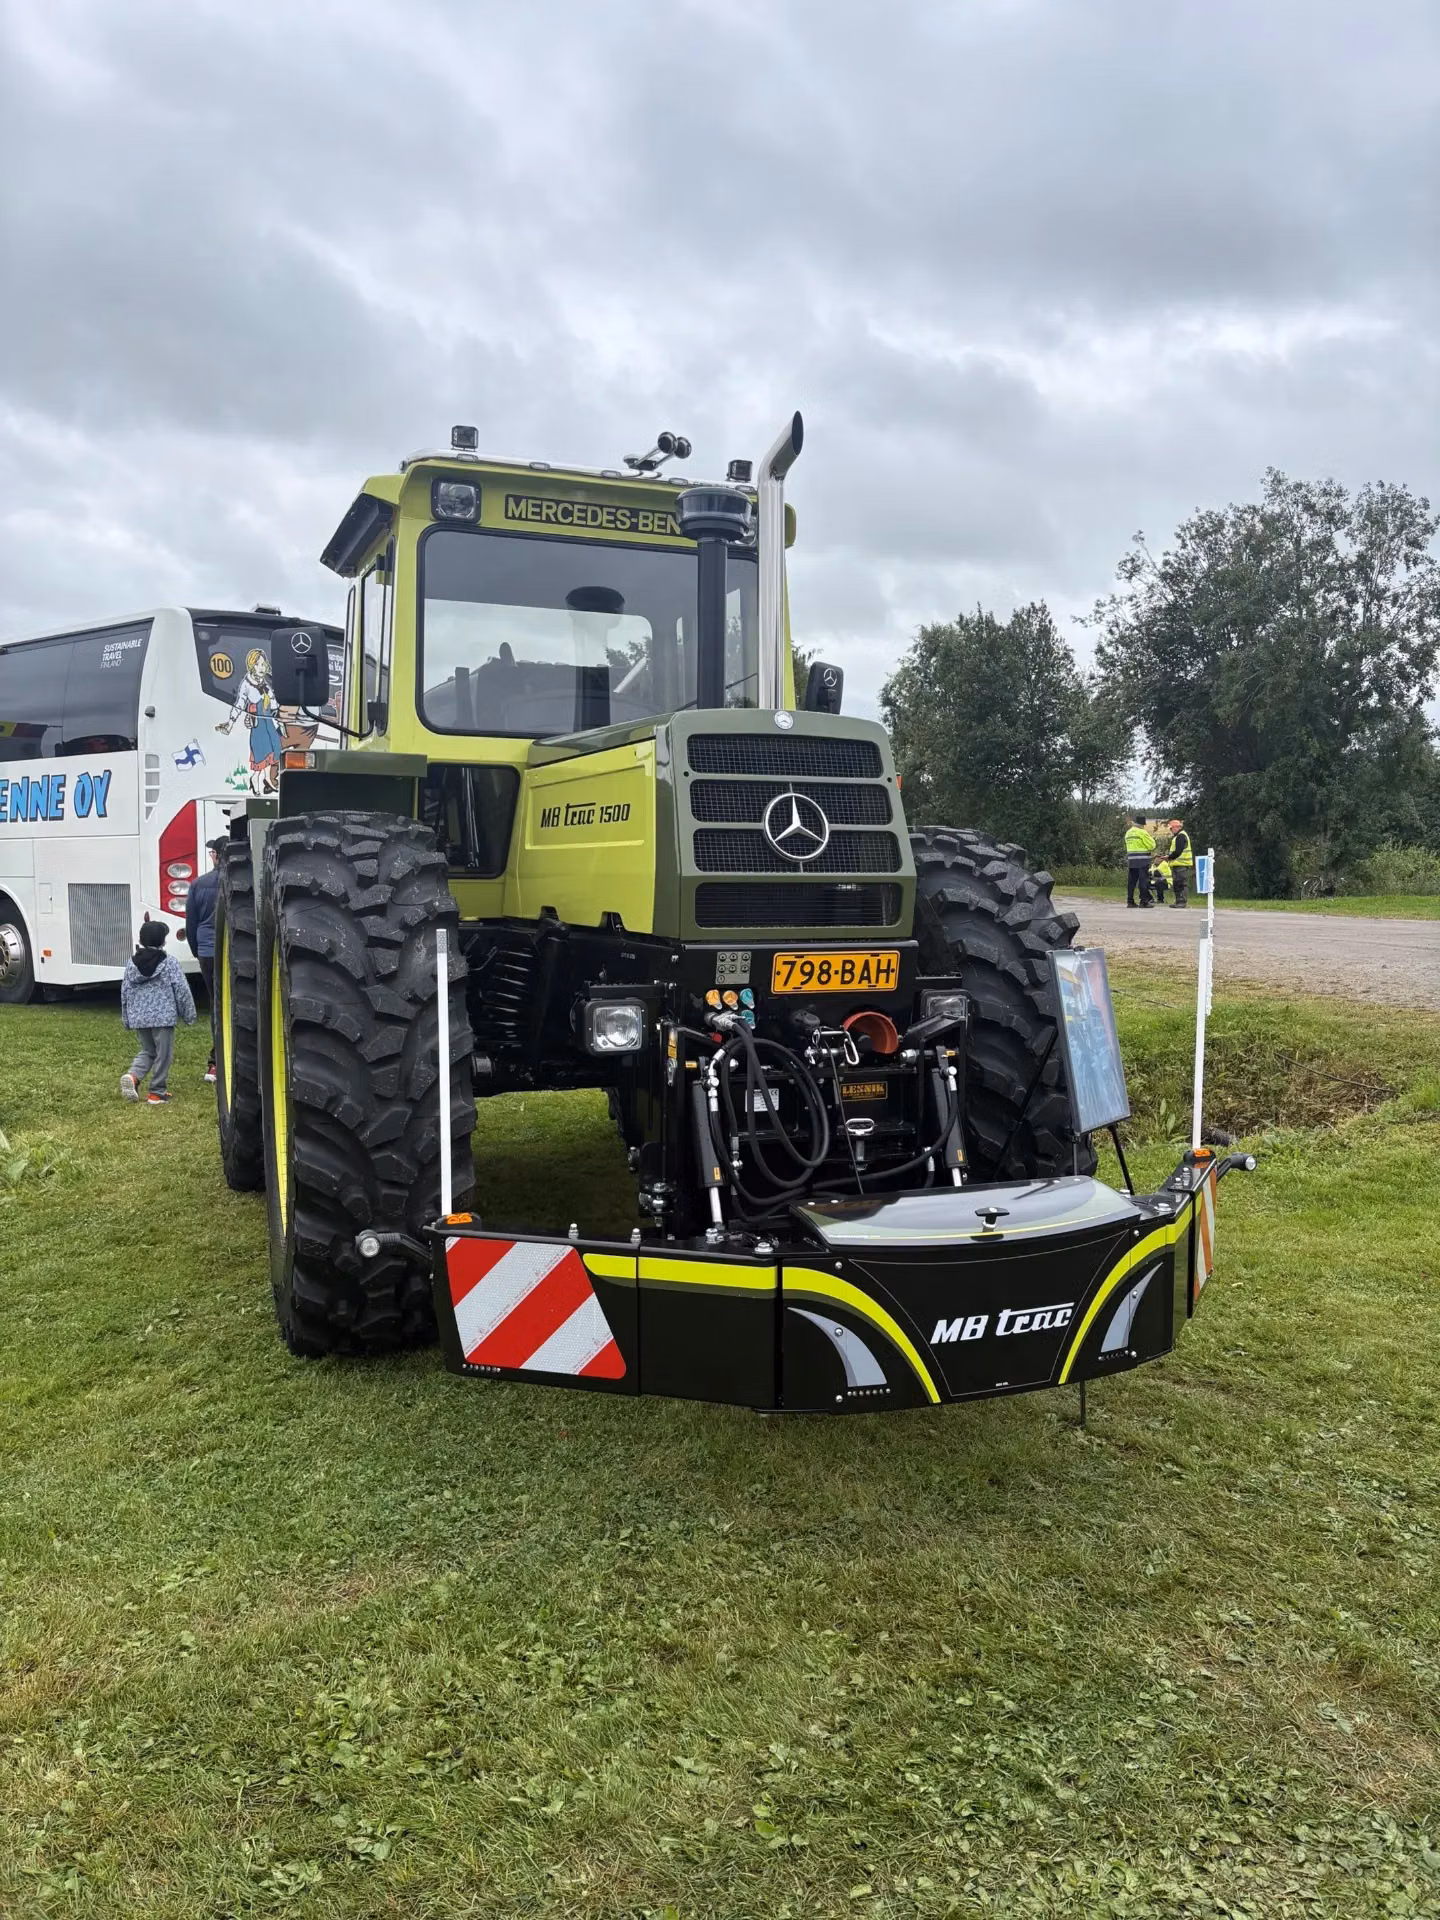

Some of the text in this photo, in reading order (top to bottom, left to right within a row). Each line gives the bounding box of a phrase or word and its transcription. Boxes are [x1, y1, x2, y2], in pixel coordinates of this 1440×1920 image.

[507, 497, 681, 535] MERCEDES-BEN
[102, 651, 122, 661] TRAVEL
[104, 639, 142, 652] SUSTAINABLE
[212, 657, 231, 673] 100
[74, 769, 112, 818] OY
[541, 802, 630, 828] MB trac 1500
[781, 959, 892, 986] 798-BAH
[930, 1302, 1075, 1344] MB trac
